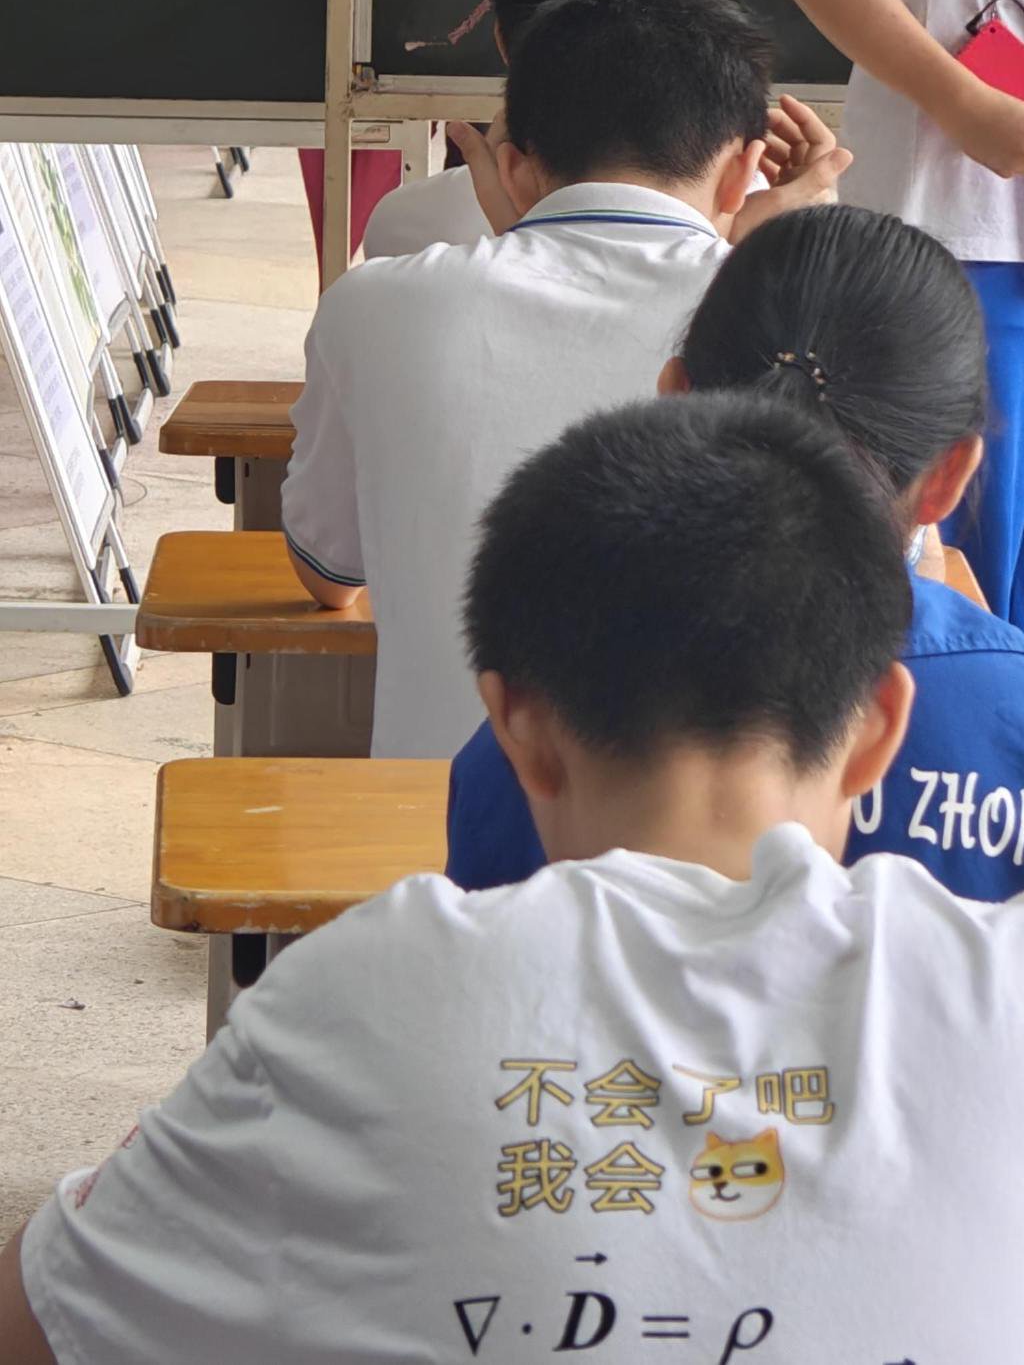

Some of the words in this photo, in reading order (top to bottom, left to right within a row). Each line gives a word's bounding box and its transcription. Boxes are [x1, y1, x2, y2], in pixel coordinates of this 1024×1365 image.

[495, 1058, 836, 1130] 不会了吧
[495, 1138, 665, 1218] 我会
